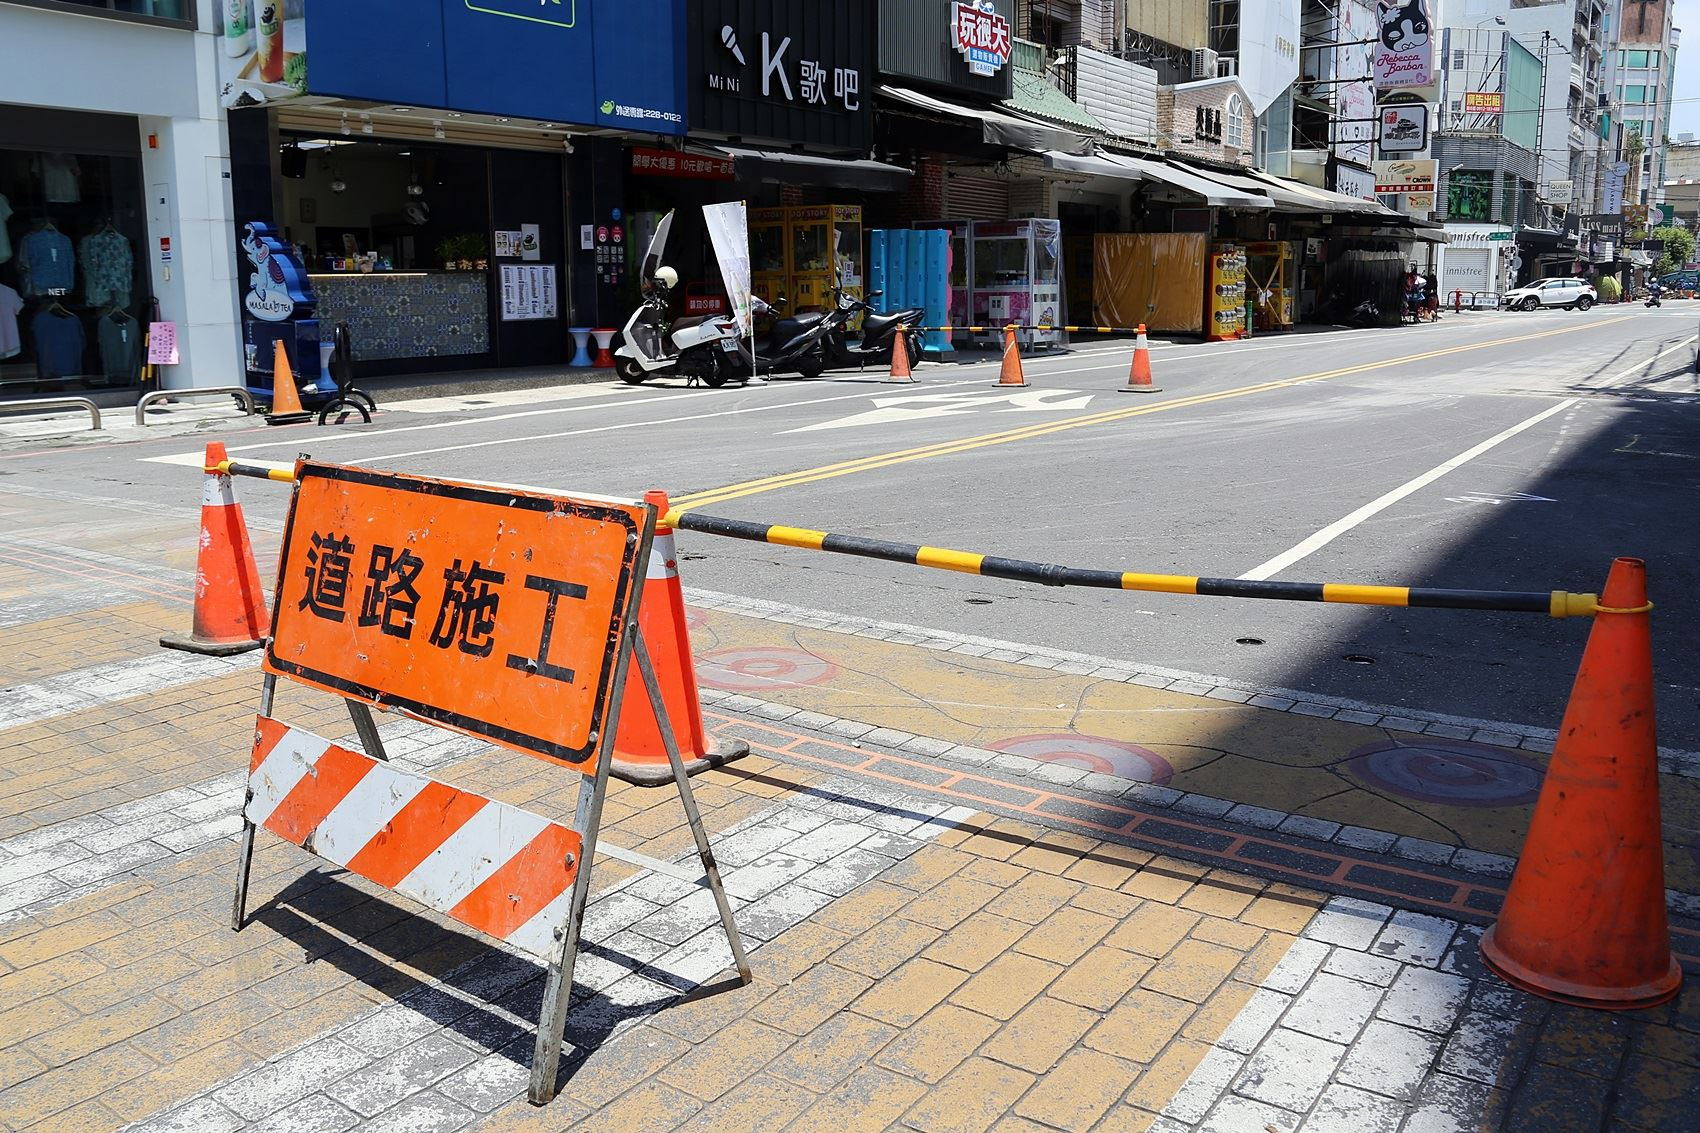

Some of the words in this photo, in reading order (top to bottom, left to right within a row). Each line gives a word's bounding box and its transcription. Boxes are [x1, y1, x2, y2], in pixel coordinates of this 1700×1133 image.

[960, 11, 1007, 53] 玩很大
[1377, 53, 1421, 67] Rebecca
[762, 31, 859, 111] K歌吧
[975, 62, 993, 73] GAMER
[1383, 62, 1424, 78] Bonbon
[1466, 94, 1501, 107] 廣告出租
[792, 210, 805, 218] TOY
[807, 209, 828, 218] STORY
[1602, 221, 1622, 233] mark
[1446, 266, 1483, 276] innisfree
[47, 287, 66, 296] NET
[249, 301, 273, 311] MASALA
[281, 303, 292, 312] TEA
[298, 530, 589, 684] 道路施工
